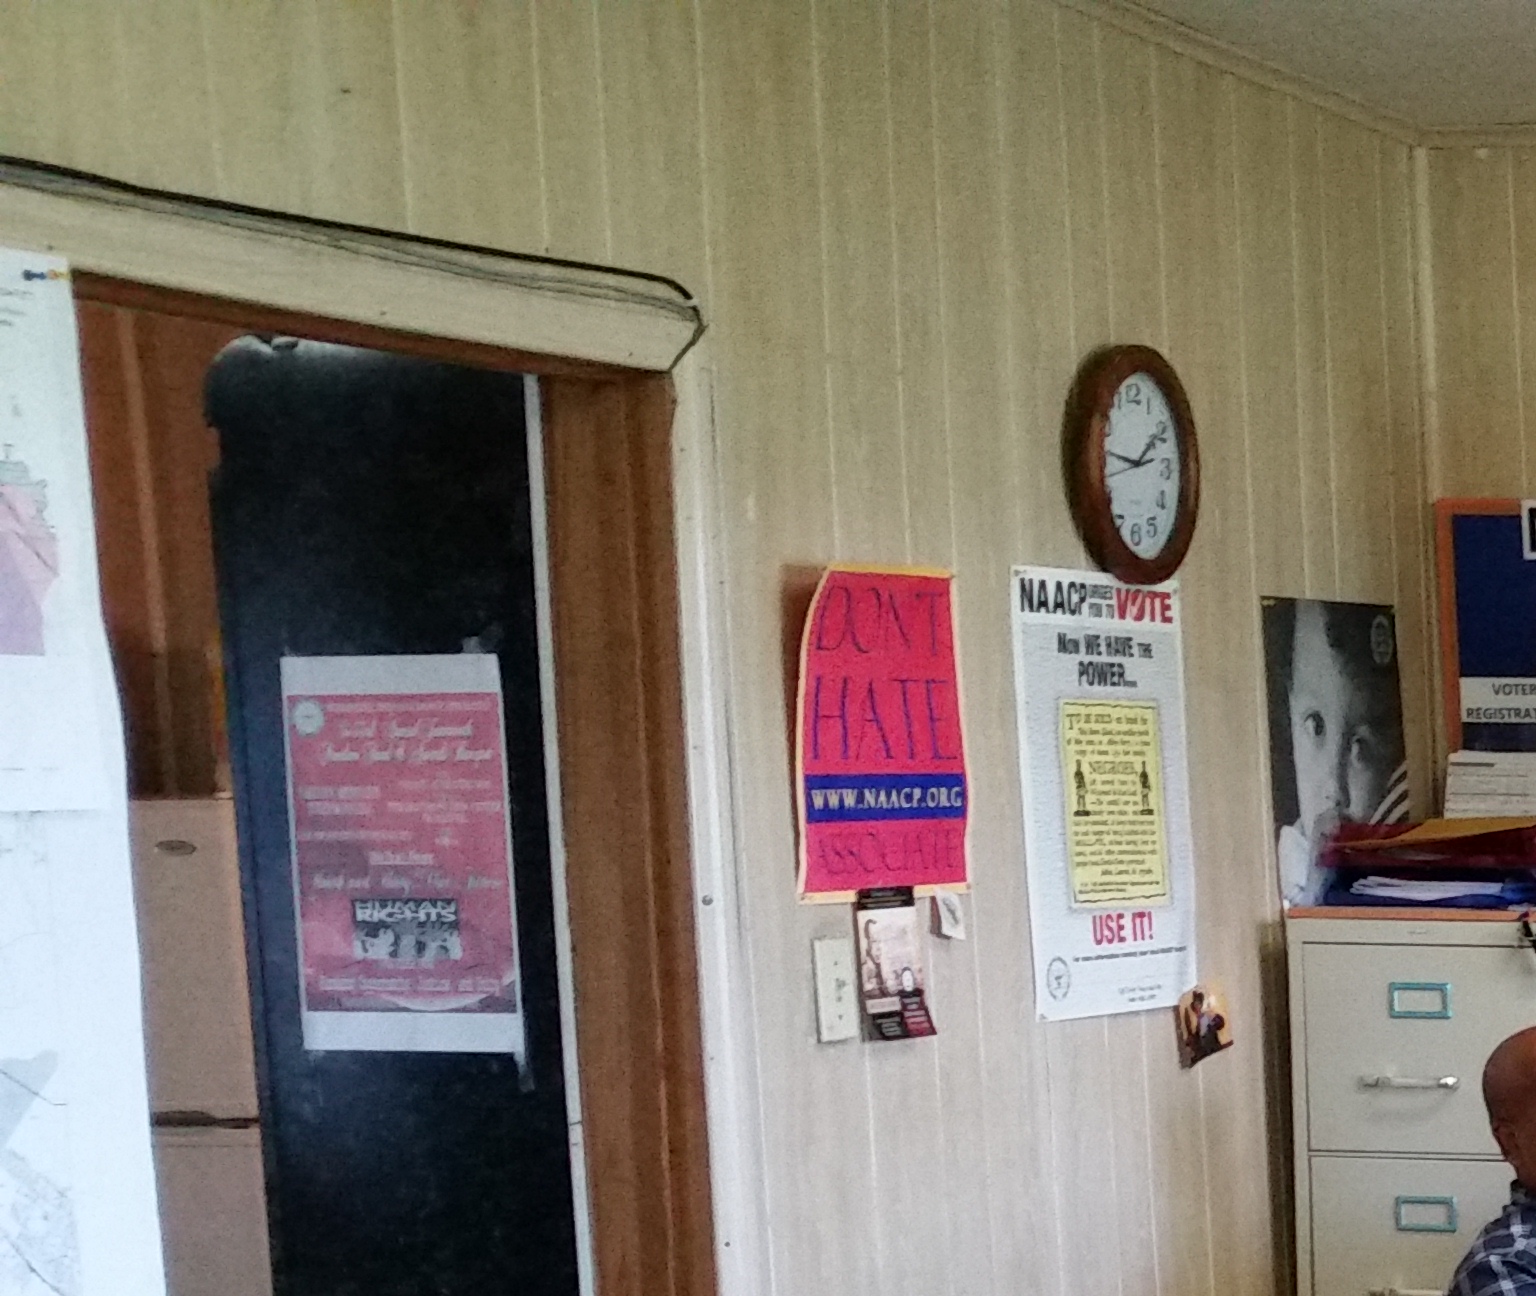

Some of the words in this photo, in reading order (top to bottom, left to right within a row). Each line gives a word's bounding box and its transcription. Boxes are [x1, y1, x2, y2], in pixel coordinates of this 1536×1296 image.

[1019, 577, 1087, 616] NAACP
[1115, 587, 1173, 624] VOTE
[1084, 634, 1103, 656] WE
[811, 675, 958, 762] HATE
[810, 786, 963, 812] WWW.NAACP.ORG
[355, 909, 457, 923] RIGHTS
[1091, 913, 1127, 946] USE
[1131, 911, 1154, 942] IT!
